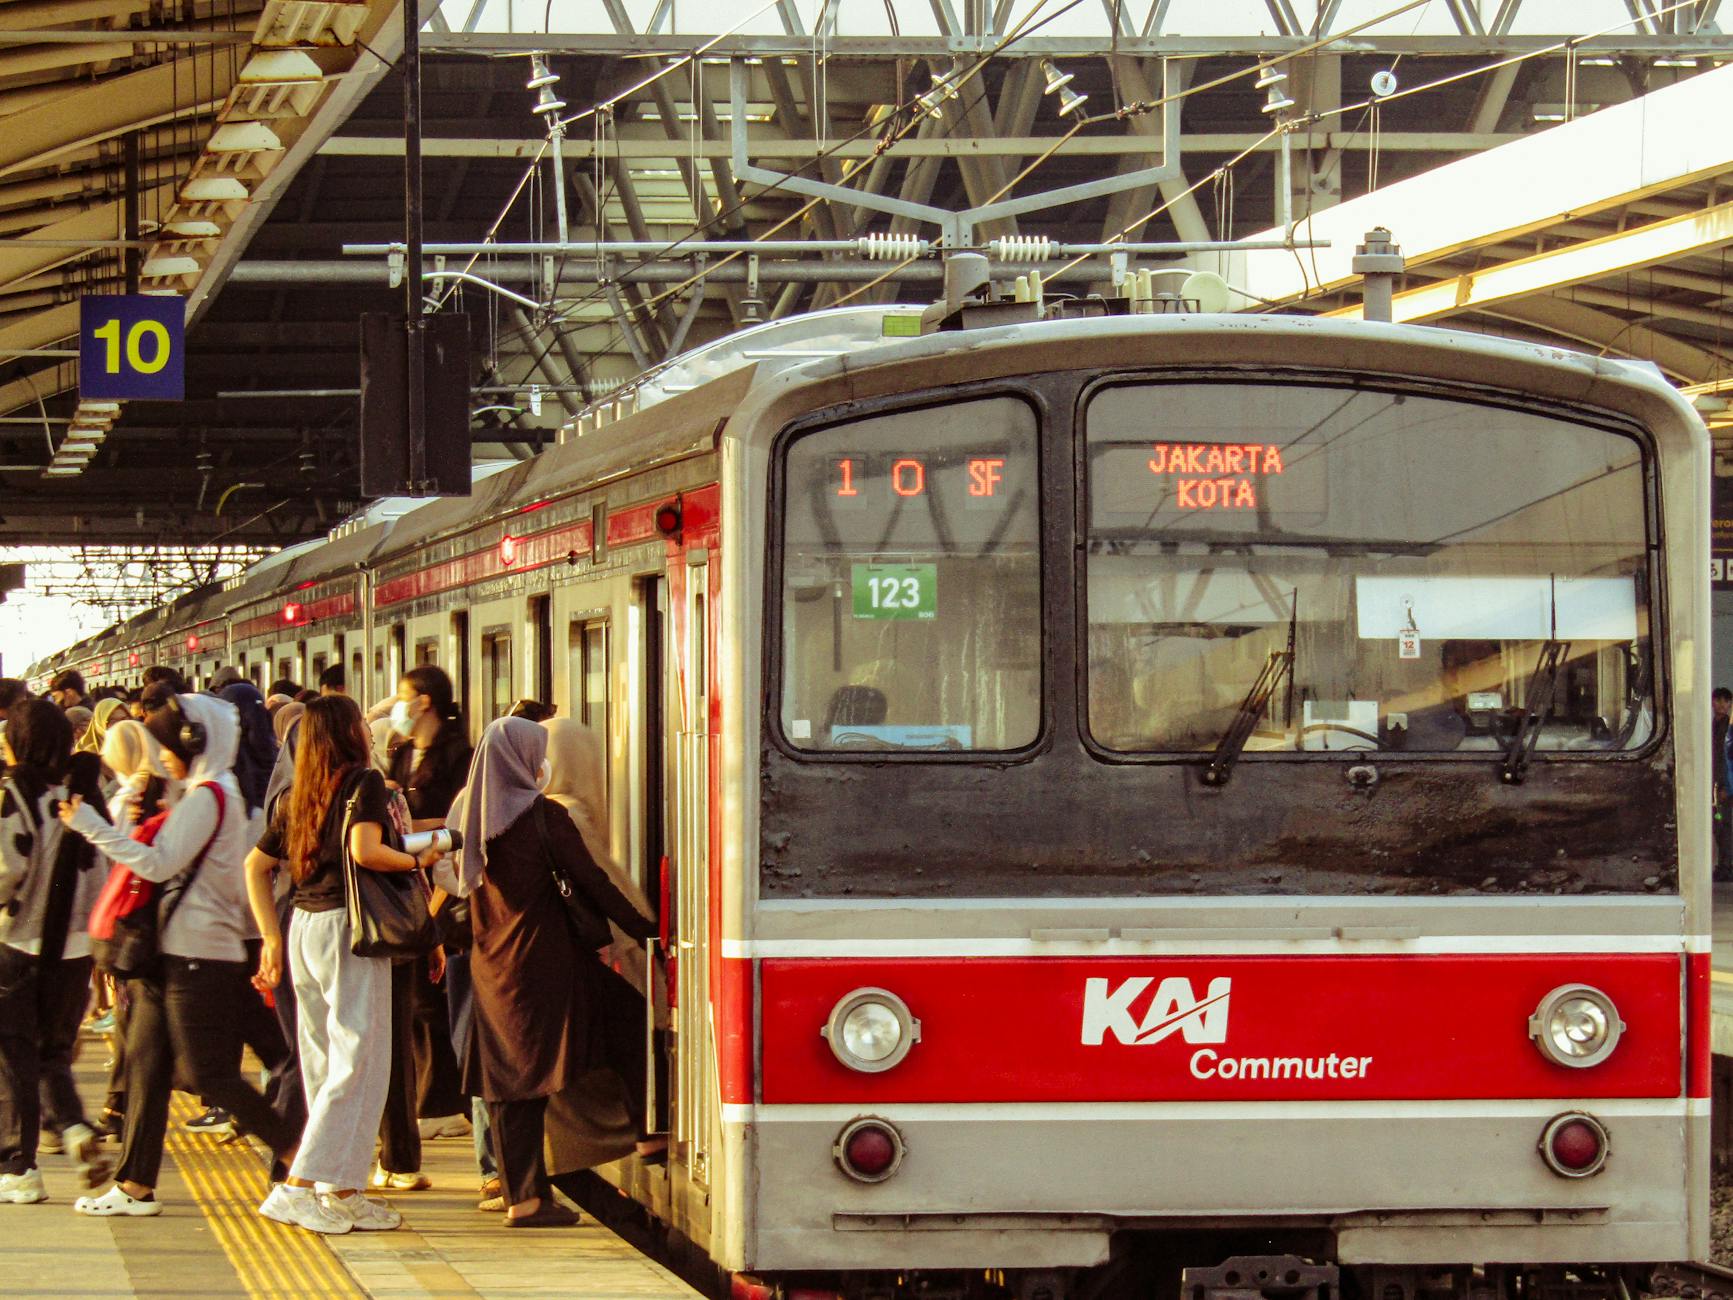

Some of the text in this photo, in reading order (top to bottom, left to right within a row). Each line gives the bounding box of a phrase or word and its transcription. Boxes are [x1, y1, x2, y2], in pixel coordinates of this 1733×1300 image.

[93, 319, 171, 374] 10
[1148, 444, 1283, 473] JAKARTA
[967, 458, 1006, 497] SF
[1177, 478, 1256, 508] KOTA
[868, 577, 920, 608] 123
[1081, 977, 1232, 1045] KAI
[1189, 1048, 1372, 1079] Commuter
